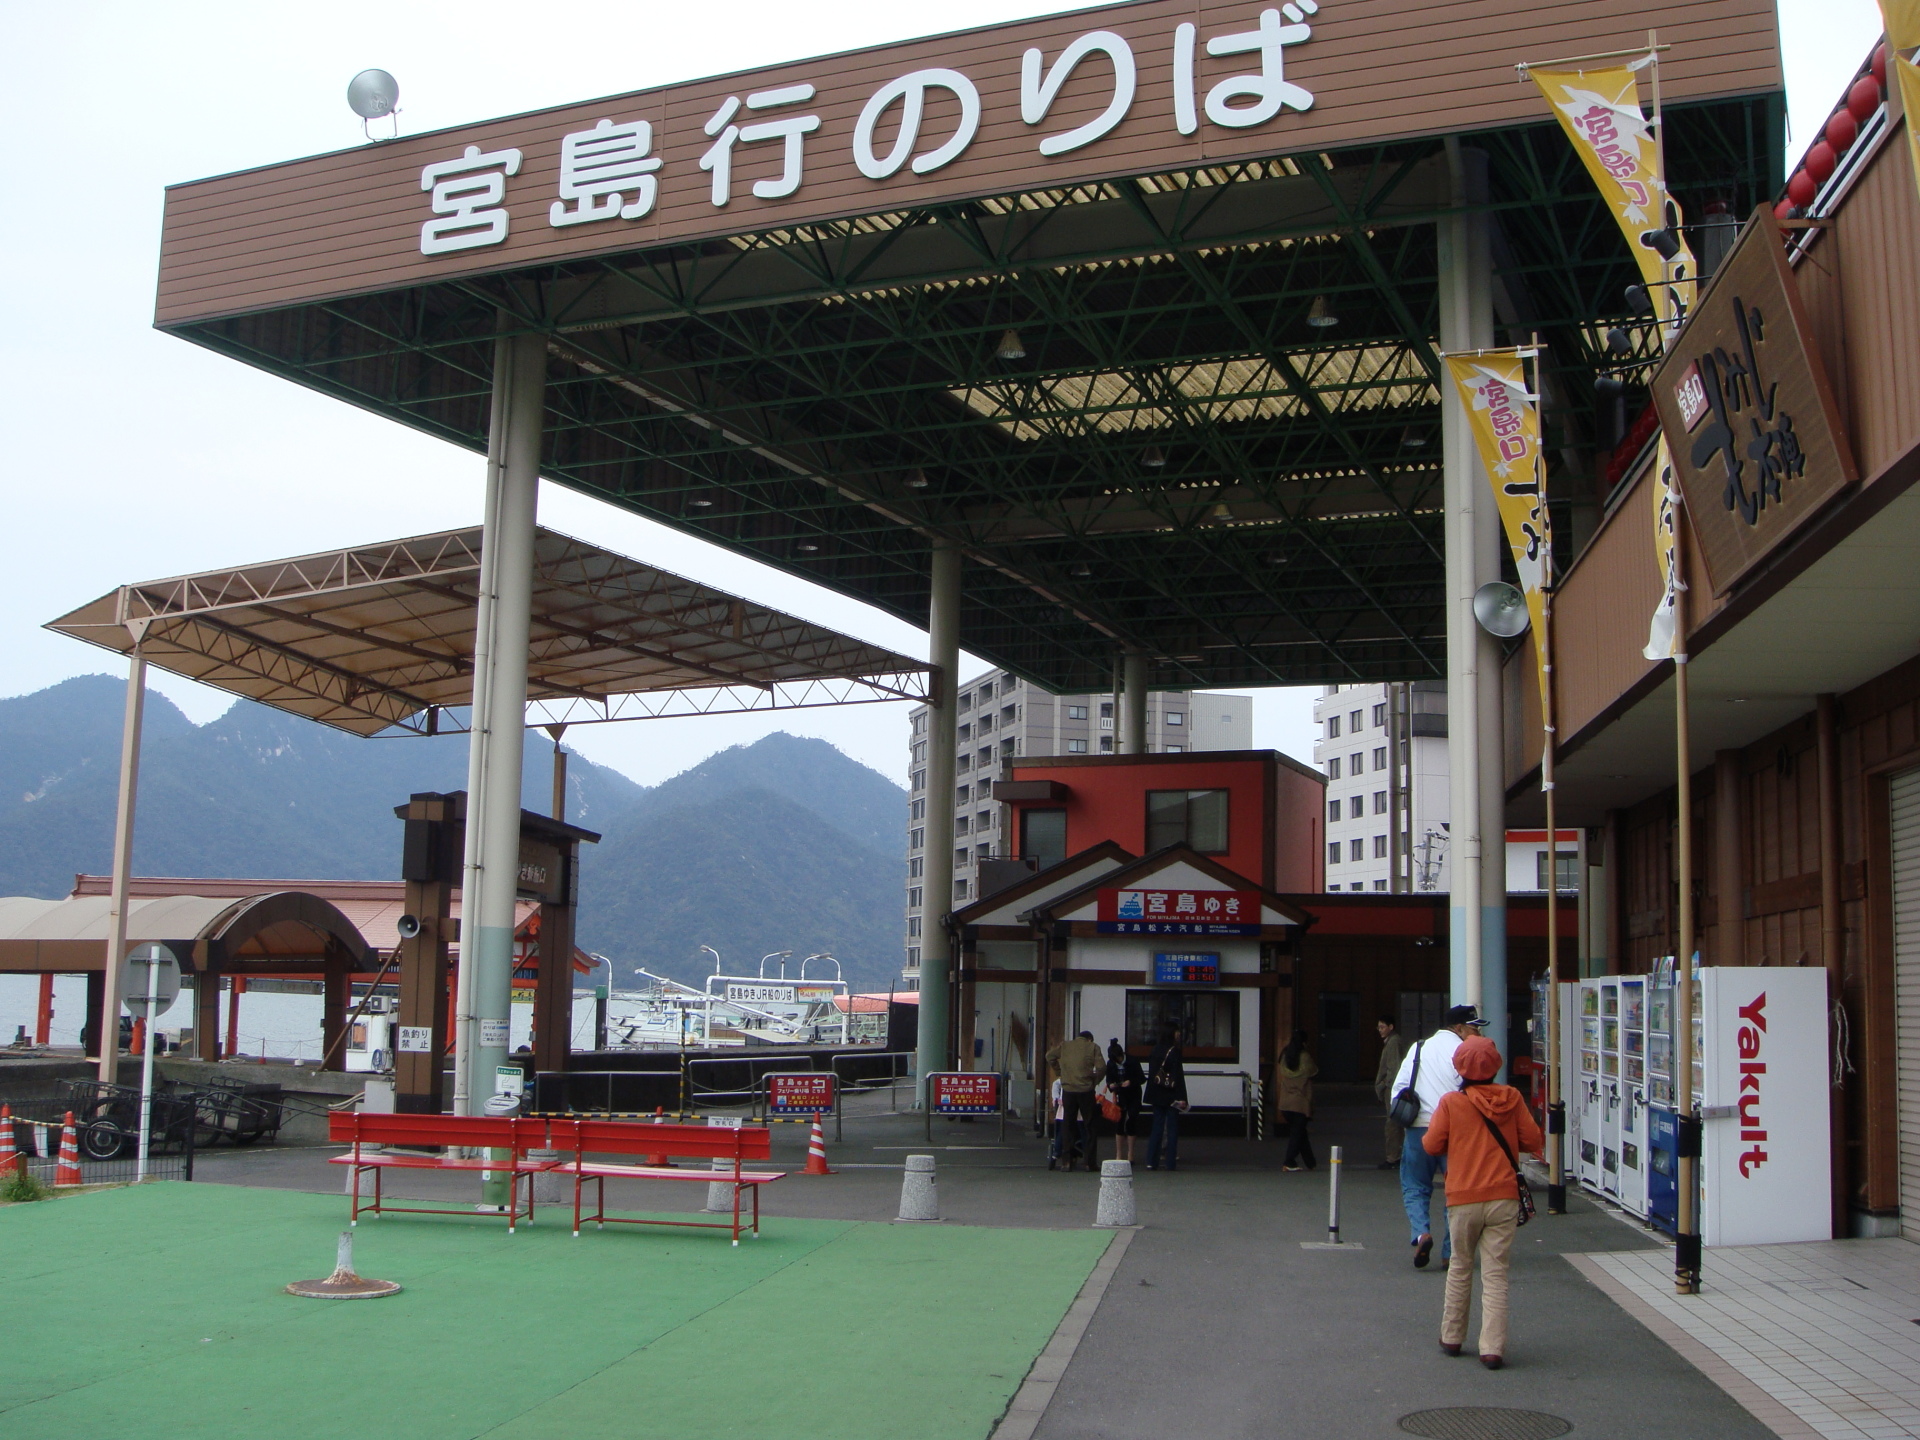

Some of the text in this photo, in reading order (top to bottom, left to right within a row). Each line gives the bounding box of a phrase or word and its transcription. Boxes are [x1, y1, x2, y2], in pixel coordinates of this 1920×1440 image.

[419, 0, 1319, 257] 宮島行のりば
[1678, 373, 1704, 423] 宮島口
[1478, 377, 1528, 462] 宮島口
[1147, 893, 1241, 914] 宮島ゆき
[1117, 923, 1203, 933] 宮島松大汽船
[729, 987, 792, 1001] 宮島ゆきJR船のりば
[401, 1028, 429, 1039] 魚釣り
[401, 1040, 429, 1049] 禁止
[777, 1078, 809, 1086] 宮島ゆき
[941, 1077, 973, 1085] 宮島ゆき
[1738, 991, 1768, 1179] Yakult
